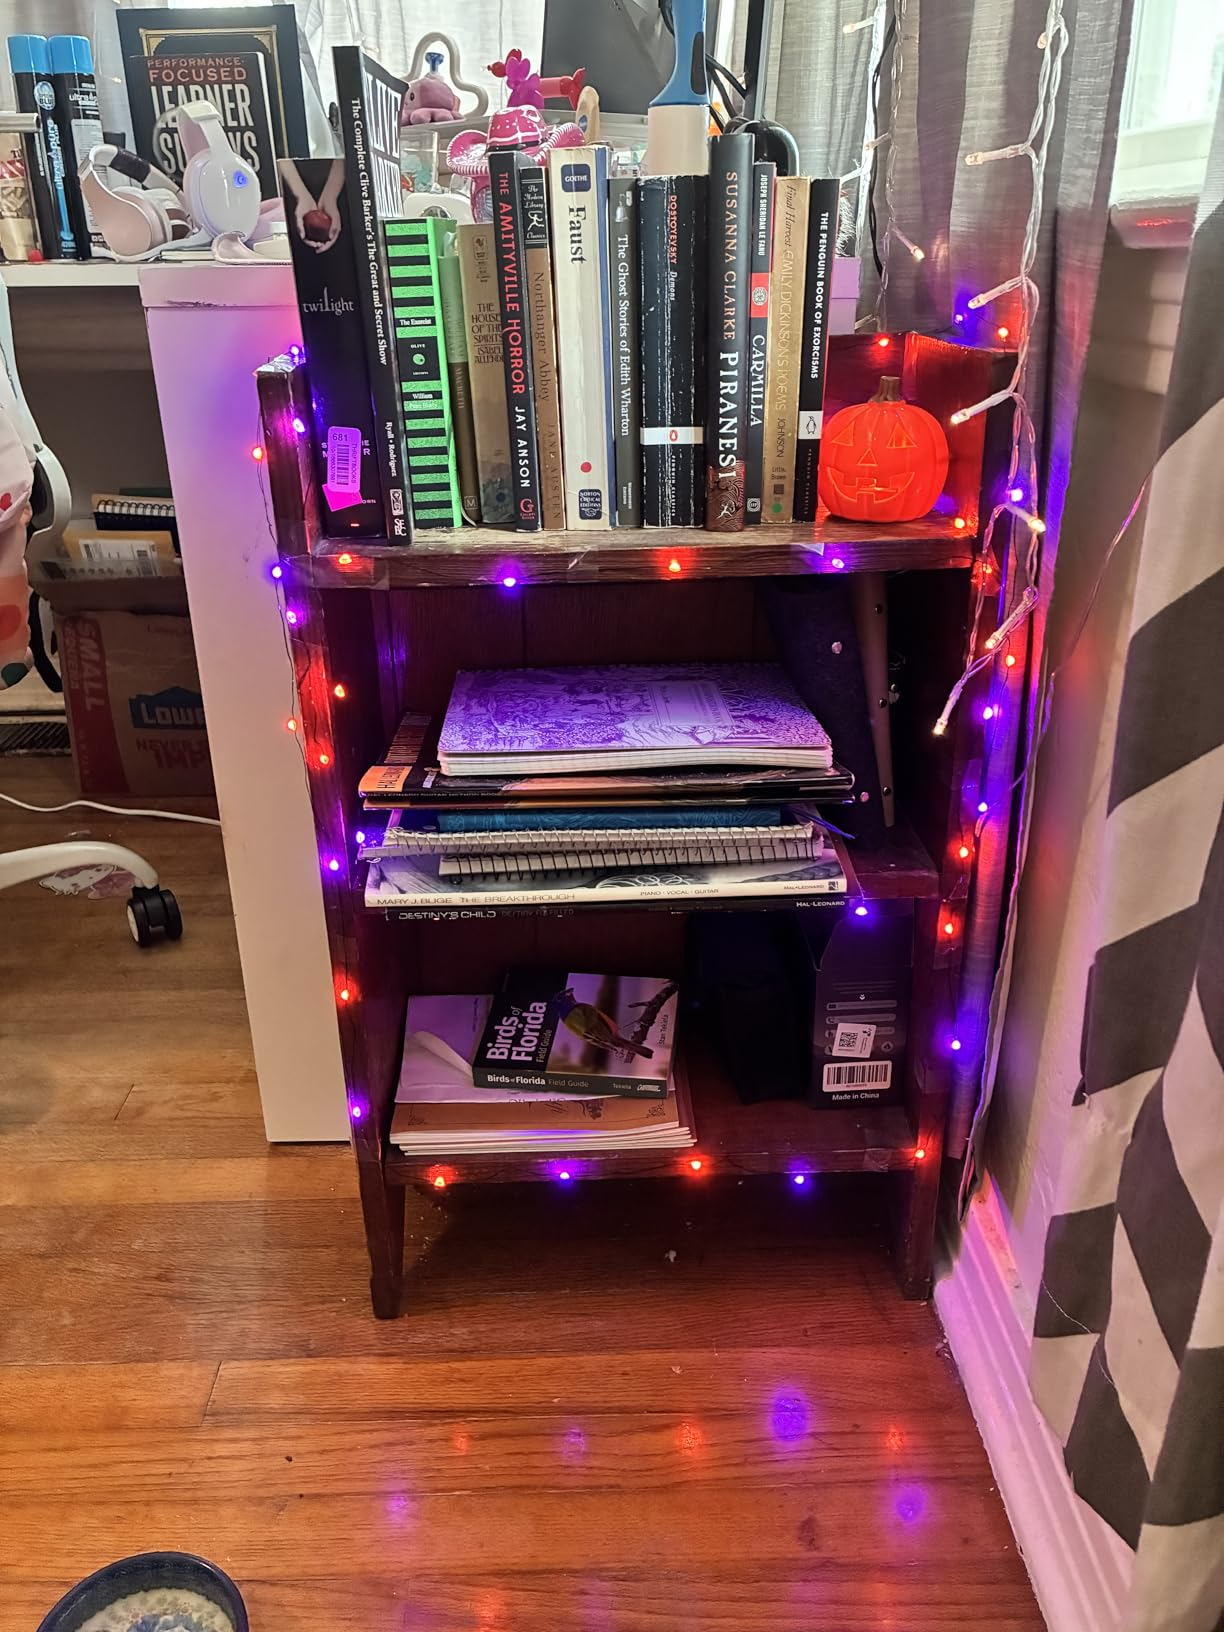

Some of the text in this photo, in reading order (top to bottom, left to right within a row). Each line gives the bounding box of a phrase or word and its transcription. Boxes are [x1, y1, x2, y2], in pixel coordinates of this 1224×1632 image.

[149, 67, 247, 82] FOCUSED
[565, 175, 588, 183] GOETHE
[785, 185, 796, 209] Final
[352, 98, 387, 365] The Complete Clive Barker's The Great and Secret Show
[758, 174, 768, 256] JOSEPH SHERIDAN LE FANU
[784, 213, 796, 247] Harvest
[568, 206, 588, 264] Faust
[669, 195, 678, 300] DOSTOYEVSKY Demons
[780, 250, 794, 288] EMILY
[303, 286, 354, 316] twilight
[477, 303, 494, 312] THE
[534, 272, 547, 354] Northanger
[810, 212, 829, 379] THE PENGUIN BOOK OF EXORCISMS
[471, 325, 484, 334] OF
[499, 172, 531, 488] THE AMITYVILLE HORROR JAY ANSON
[617, 234, 632, 436] The Ghost Stories of Edith Wharton
[718, 172, 739, 478] SUSANNA CLARKE PIRANESI
[538, 360, 552, 402] Abbey
[750, 334, 765, 427] CARMILLA
[332, 433, 349, 441] 681
[776, 417, 786, 458] JOHNSON
[520, 499, 535, 513] G
[550, 467, 561, 519] AUSTEN
[78, 620, 106, 711] SMALL
[377, 897, 409, 905] MARY
[484, 893, 576, 903] BREAKTHROUGH
[399, 911, 460, 919] DESTINY'S
[460, 910, 497, 918] CHILD
[486, 1006, 523, 1060] Birds of
[511, 1002, 548, 1061] Florida
[535, 1029, 553, 1063] Field Guide
[657, 1034, 666, 1046] Stan
[487, 1075, 510, 1084] Birds
[515, 1076, 546, 1086] Florida
[548, 1078, 565, 1087] Field
[568, 1080, 589, 1088] Guide
[832, 1093, 851, 1101] Made
